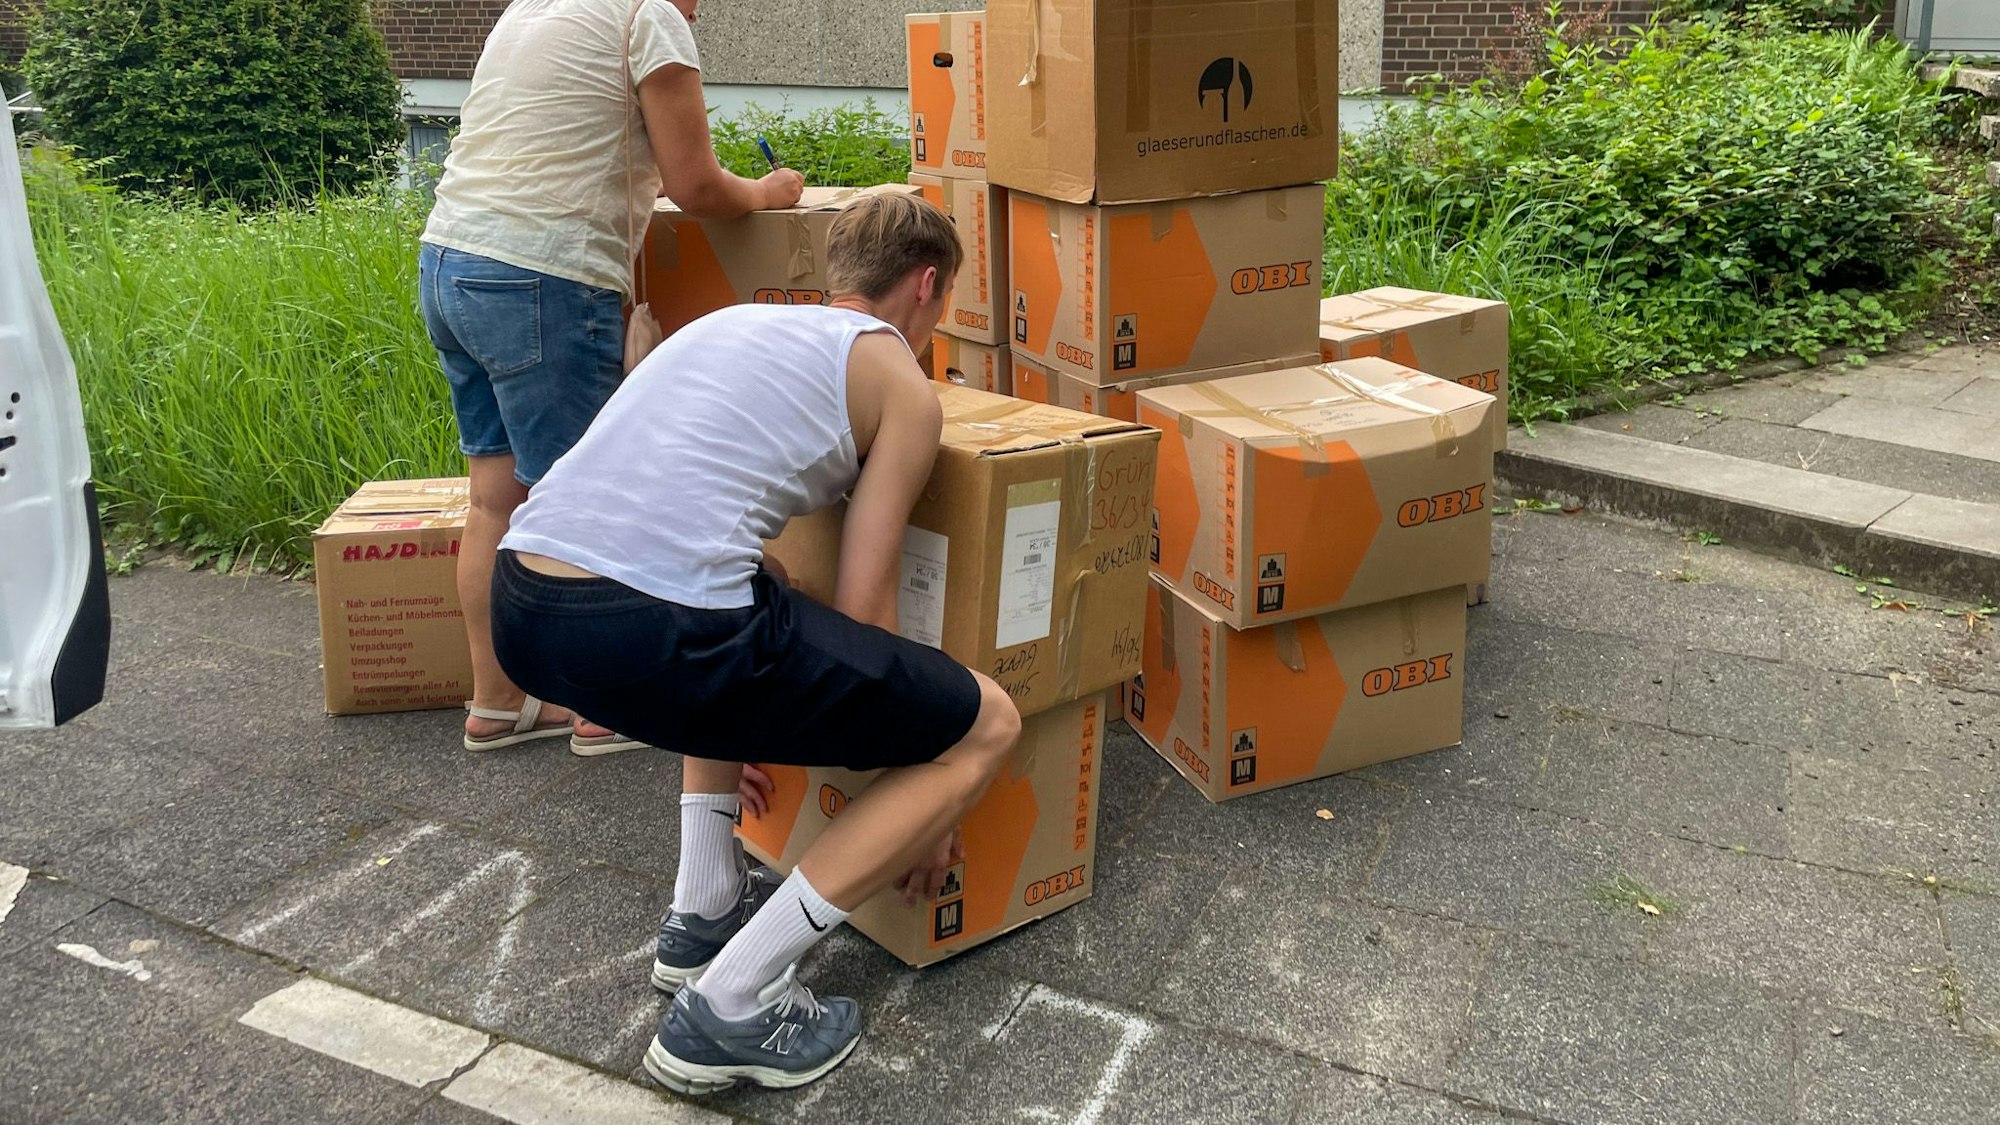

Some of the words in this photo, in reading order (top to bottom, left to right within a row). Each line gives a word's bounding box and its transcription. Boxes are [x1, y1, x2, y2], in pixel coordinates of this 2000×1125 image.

[1137, 122, 1308, 157] glaeserundflaschen.de
[952, 150, 986, 168] OBI
[1230, 261, 1312, 295] OBI
[754, 288, 831, 304] OB
[955, 309, 988, 330] OBI
[1056, 342, 1094, 369] OBI
[1118, 345, 1132, 362] M
[1450, 369, 1499, 393] BI
[1099, 450, 1150, 491] Grün
[1091, 490, 1150, 531] 36/34
[1397, 483, 1486, 528] OBI
[1193, 571, 1234, 612] OBI
[1263, 587, 1279, 604] M
[346, 599, 367, 609] Nah-
[371, 598, 387, 608] und
[390, 596, 444, 607] Fernumzüge
[348, 613, 383, 623] Küchen-
[386, 611, 403, 621] und
[406, 609, 464, 620] Möbelmonta
[349, 628, 404, 638] Beiladungen
[350, 641, 414, 653] Verpackungen
[351, 656, 407, 667] Umzugsshop
[352, 669, 426, 681] Entrümpelungen
[1362, 652, 1452, 697] OBI
[422, 681, 442, 691] aller
[446, 681, 459, 690] Art
[356, 698, 378, 707] Auch
[408, 695, 425, 704] und
[1174, 737, 1210, 783] OBI
[1236, 759, 1251, 777] M
[1024, 864, 1086, 907] OBI
[941, 904, 957, 929] M
